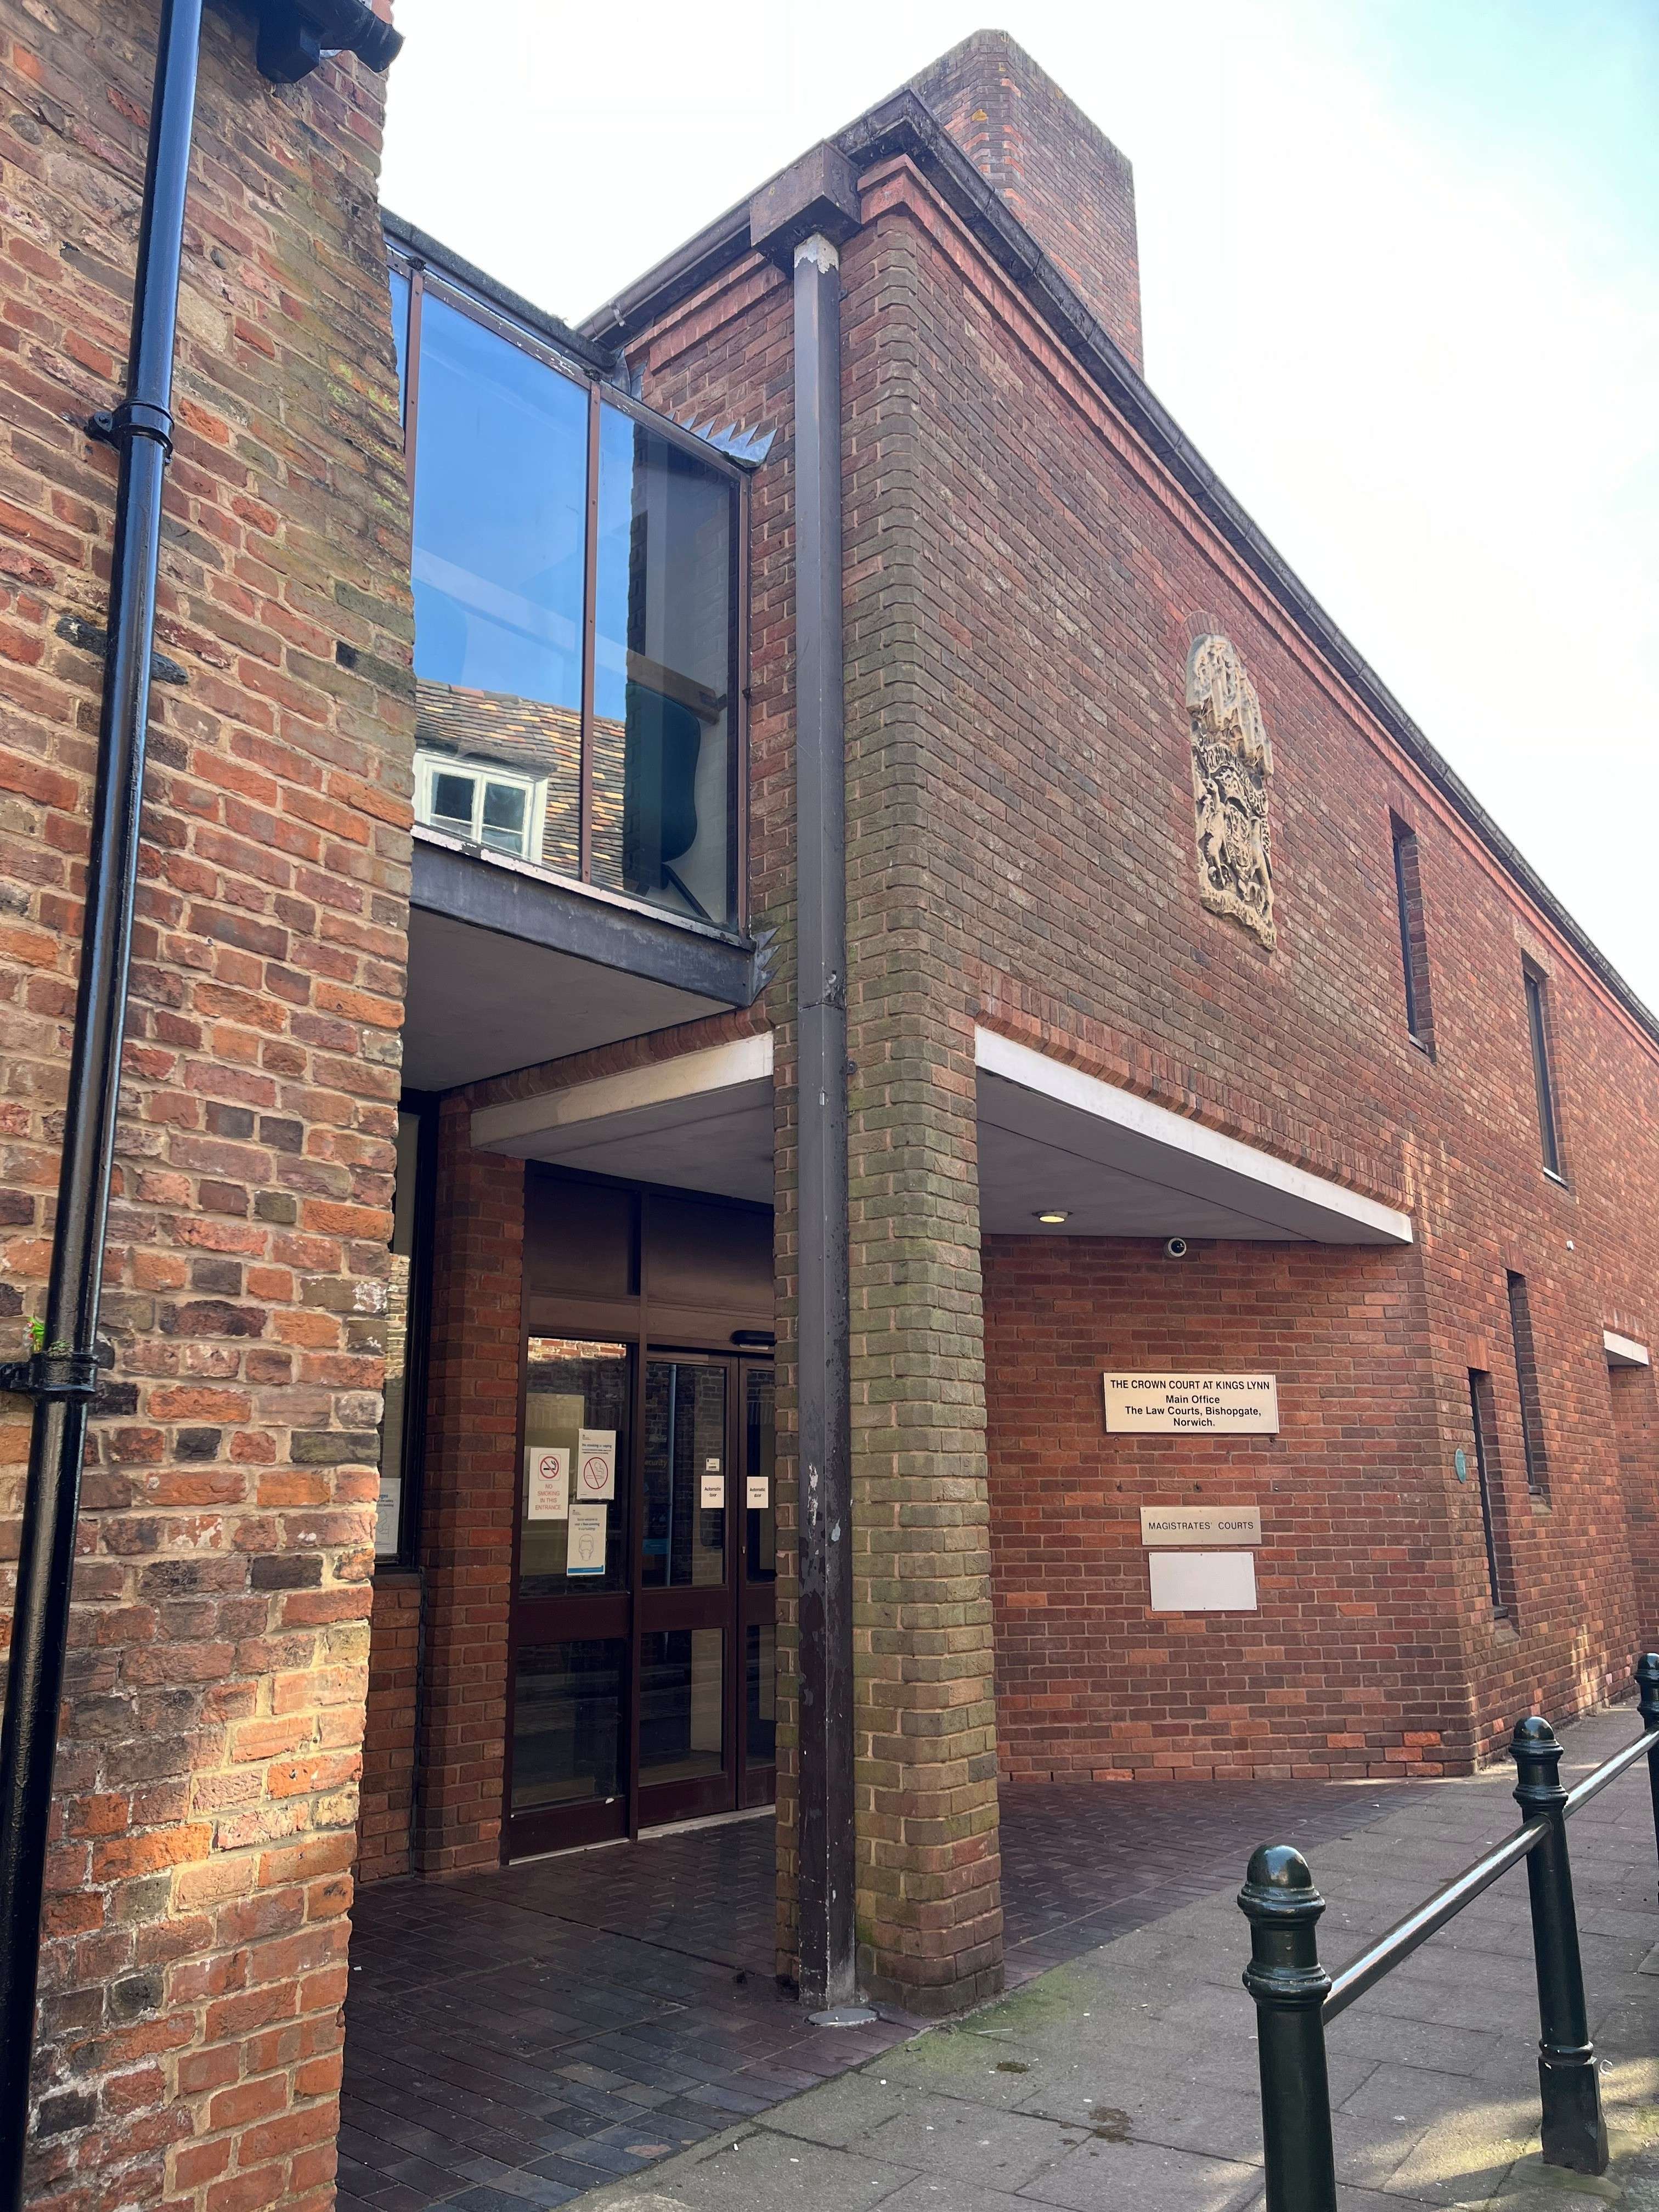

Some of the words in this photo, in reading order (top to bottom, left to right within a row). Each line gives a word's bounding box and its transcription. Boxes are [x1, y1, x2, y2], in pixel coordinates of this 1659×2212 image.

[1110, 1380, 1129, 1389] THE
[1131, 1380, 1166, 1389] CROWN
[1169, 1380, 1200, 1389] COURT
[1203, 1381, 1214, 1389] AT
[1216, 1381, 1245, 1390] KINGS
[1247, 1381, 1270, 1390] LYNN
[1165, 1395, 1189, 1403] Main
[1192, 1395, 1220, 1403] Office
[1125, 1406, 1143, 1414] The
[1146, 1406, 1165, 1414] Law
[1167, 1406, 1203, 1417] Courts,
[1205, 1406, 1261, 1417] Bishopgate,
[1173, 1418, 1215, 1426] Norwich.
